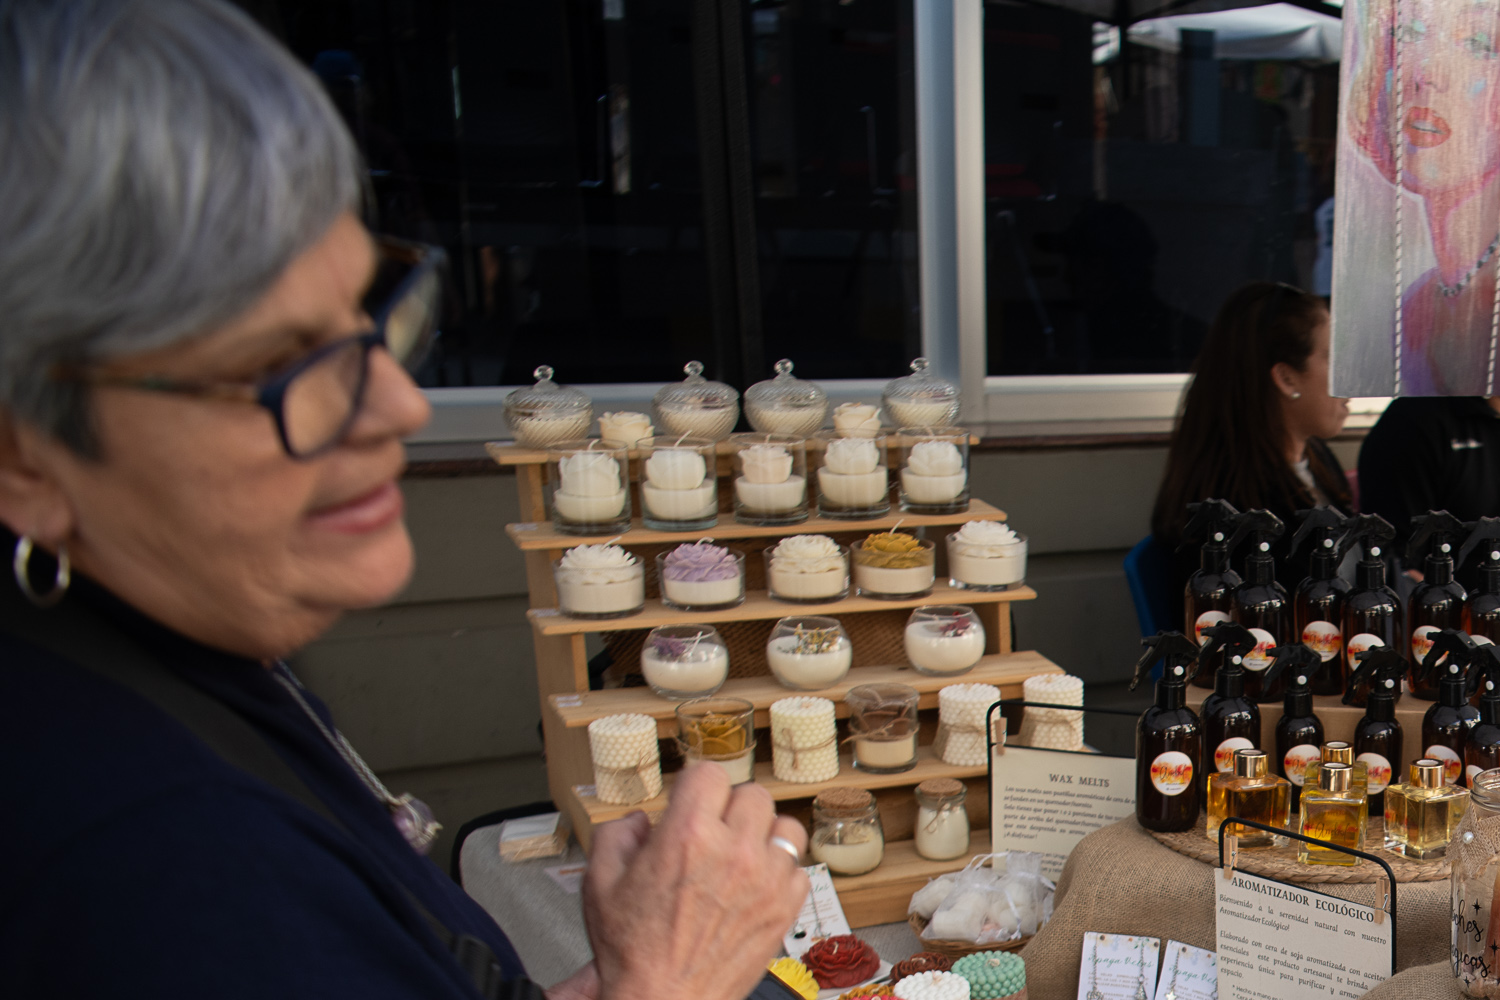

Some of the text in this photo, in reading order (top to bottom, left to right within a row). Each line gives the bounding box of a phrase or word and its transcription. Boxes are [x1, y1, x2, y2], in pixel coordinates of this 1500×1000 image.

[1049, 774, 1109, 788] WAX MELTS
[1219, 907, 1261, 923] Aromatizador
[1232, 878, 1374, 922] AROMATIZADOR ECOLÓGICO
[1268, 906, 1274, 915] la
[1279, 912, 1309, 924] serenidad
[1314, 921, 1338, 932] natural
[1344, 929, 1356, 937] con
[1361, 934, 1387, 945] nuestro
[1452, 899, 1484, 942] ches
[1220, 930, 1249, 944] Elaborado
[1251, 940, 1262, 948] con
[1265, 944, 1278, 952] cera
[1280, 947, 1288, 955] de
[1290, 952, 1303, 961] soja
[1306, 956, 1346, 972] aromatizada
[1349, 968, 1361, 976] con
[1257, 954, 1270, 962] este
[1273, 959, 1300, 971] producto
[1303, 968, 1333, 980] artesanal
[1347, 978, 1368, 990] brinda
[1220, 956, 1254, 969] experiencia
[1258, 965, 1275, 975] única
[1279, 972, 1294, 981] para
[1298, 978, 1325, 990] purificar
[1330, 987, 1335, 995] y
[1257, 992, 1271, 1000] mano
